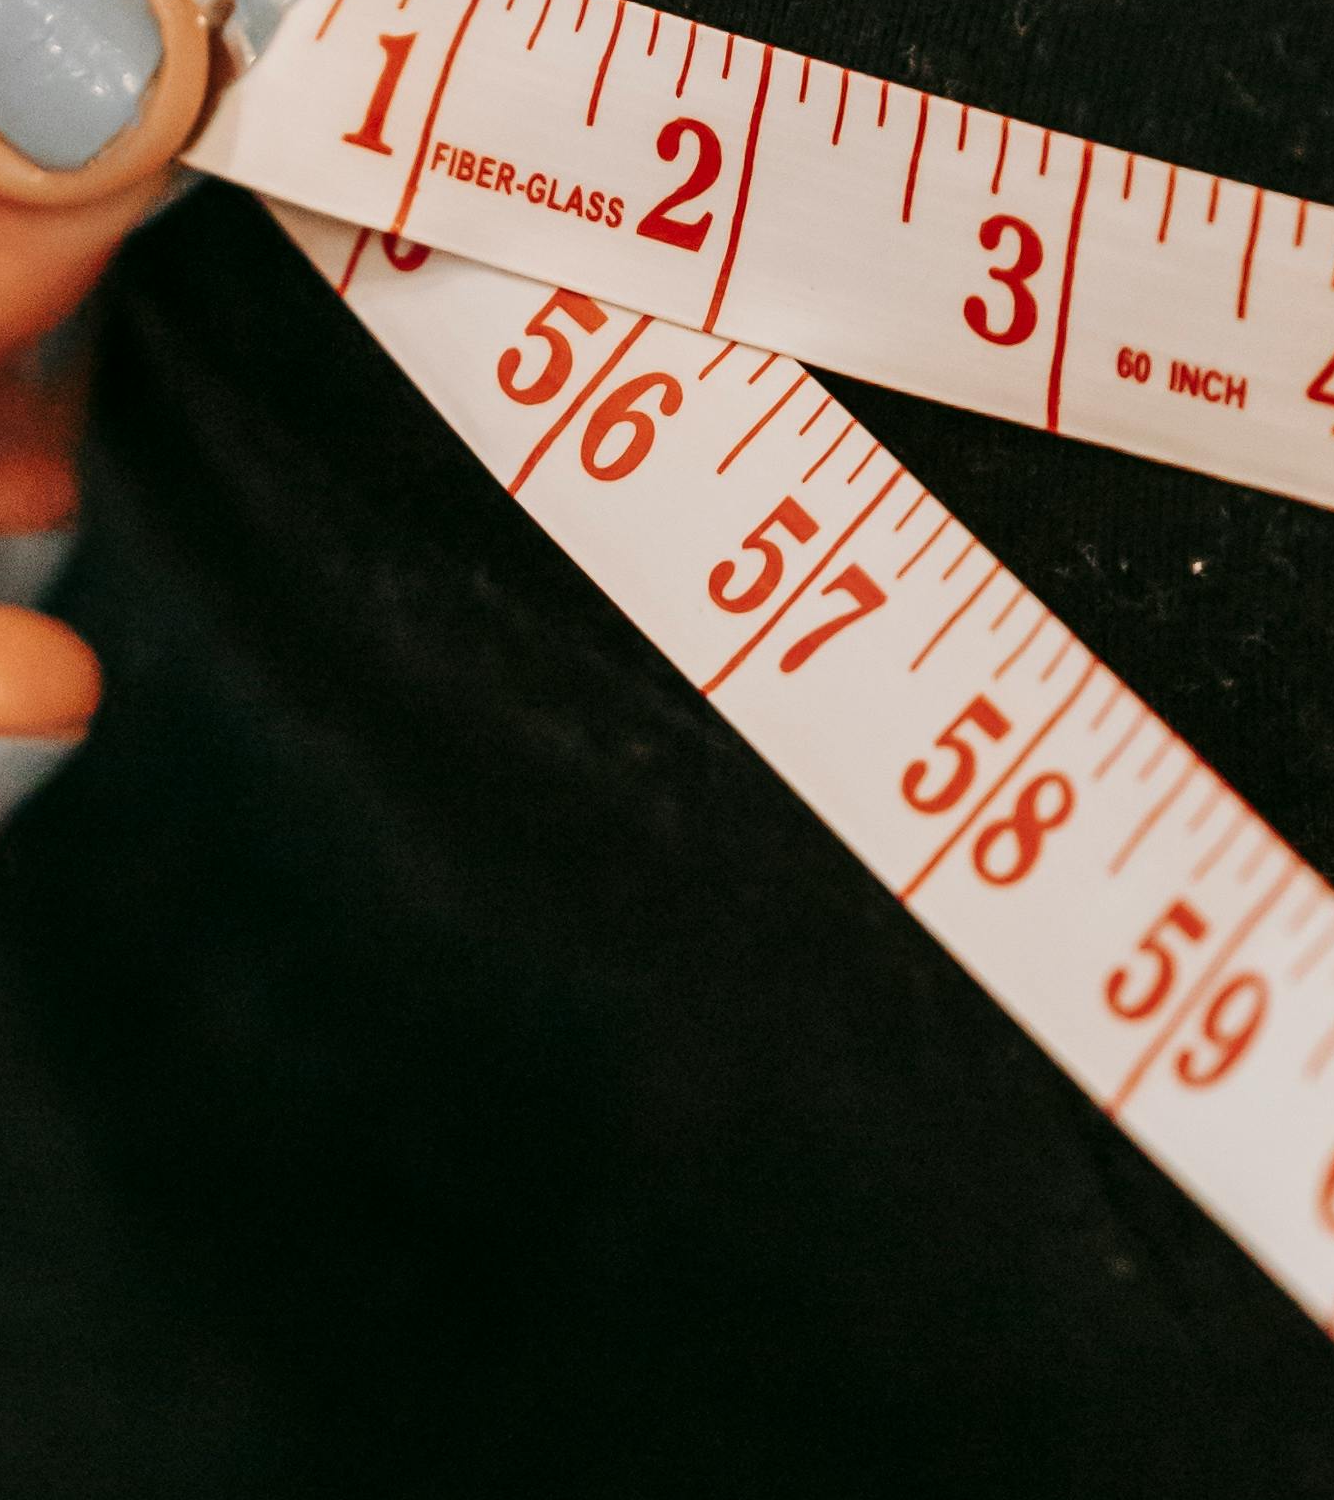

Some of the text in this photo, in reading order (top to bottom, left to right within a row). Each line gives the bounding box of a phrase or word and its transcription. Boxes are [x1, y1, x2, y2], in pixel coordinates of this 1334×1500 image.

[342, 31, 418, 157] 1
[429, 141, 625, 230] FIBER-GLASS
[634, 116, 724, 253] 2
[962, 212, 1045, 348] 3
[496, 286, 684, 484] 56
[1115, 344, 1249, 411] 60 INCH
[707, 494, 889, 676] 57
[899, 693, 1076, 889] 58
[1103, 898, 1270, 1090] 59
